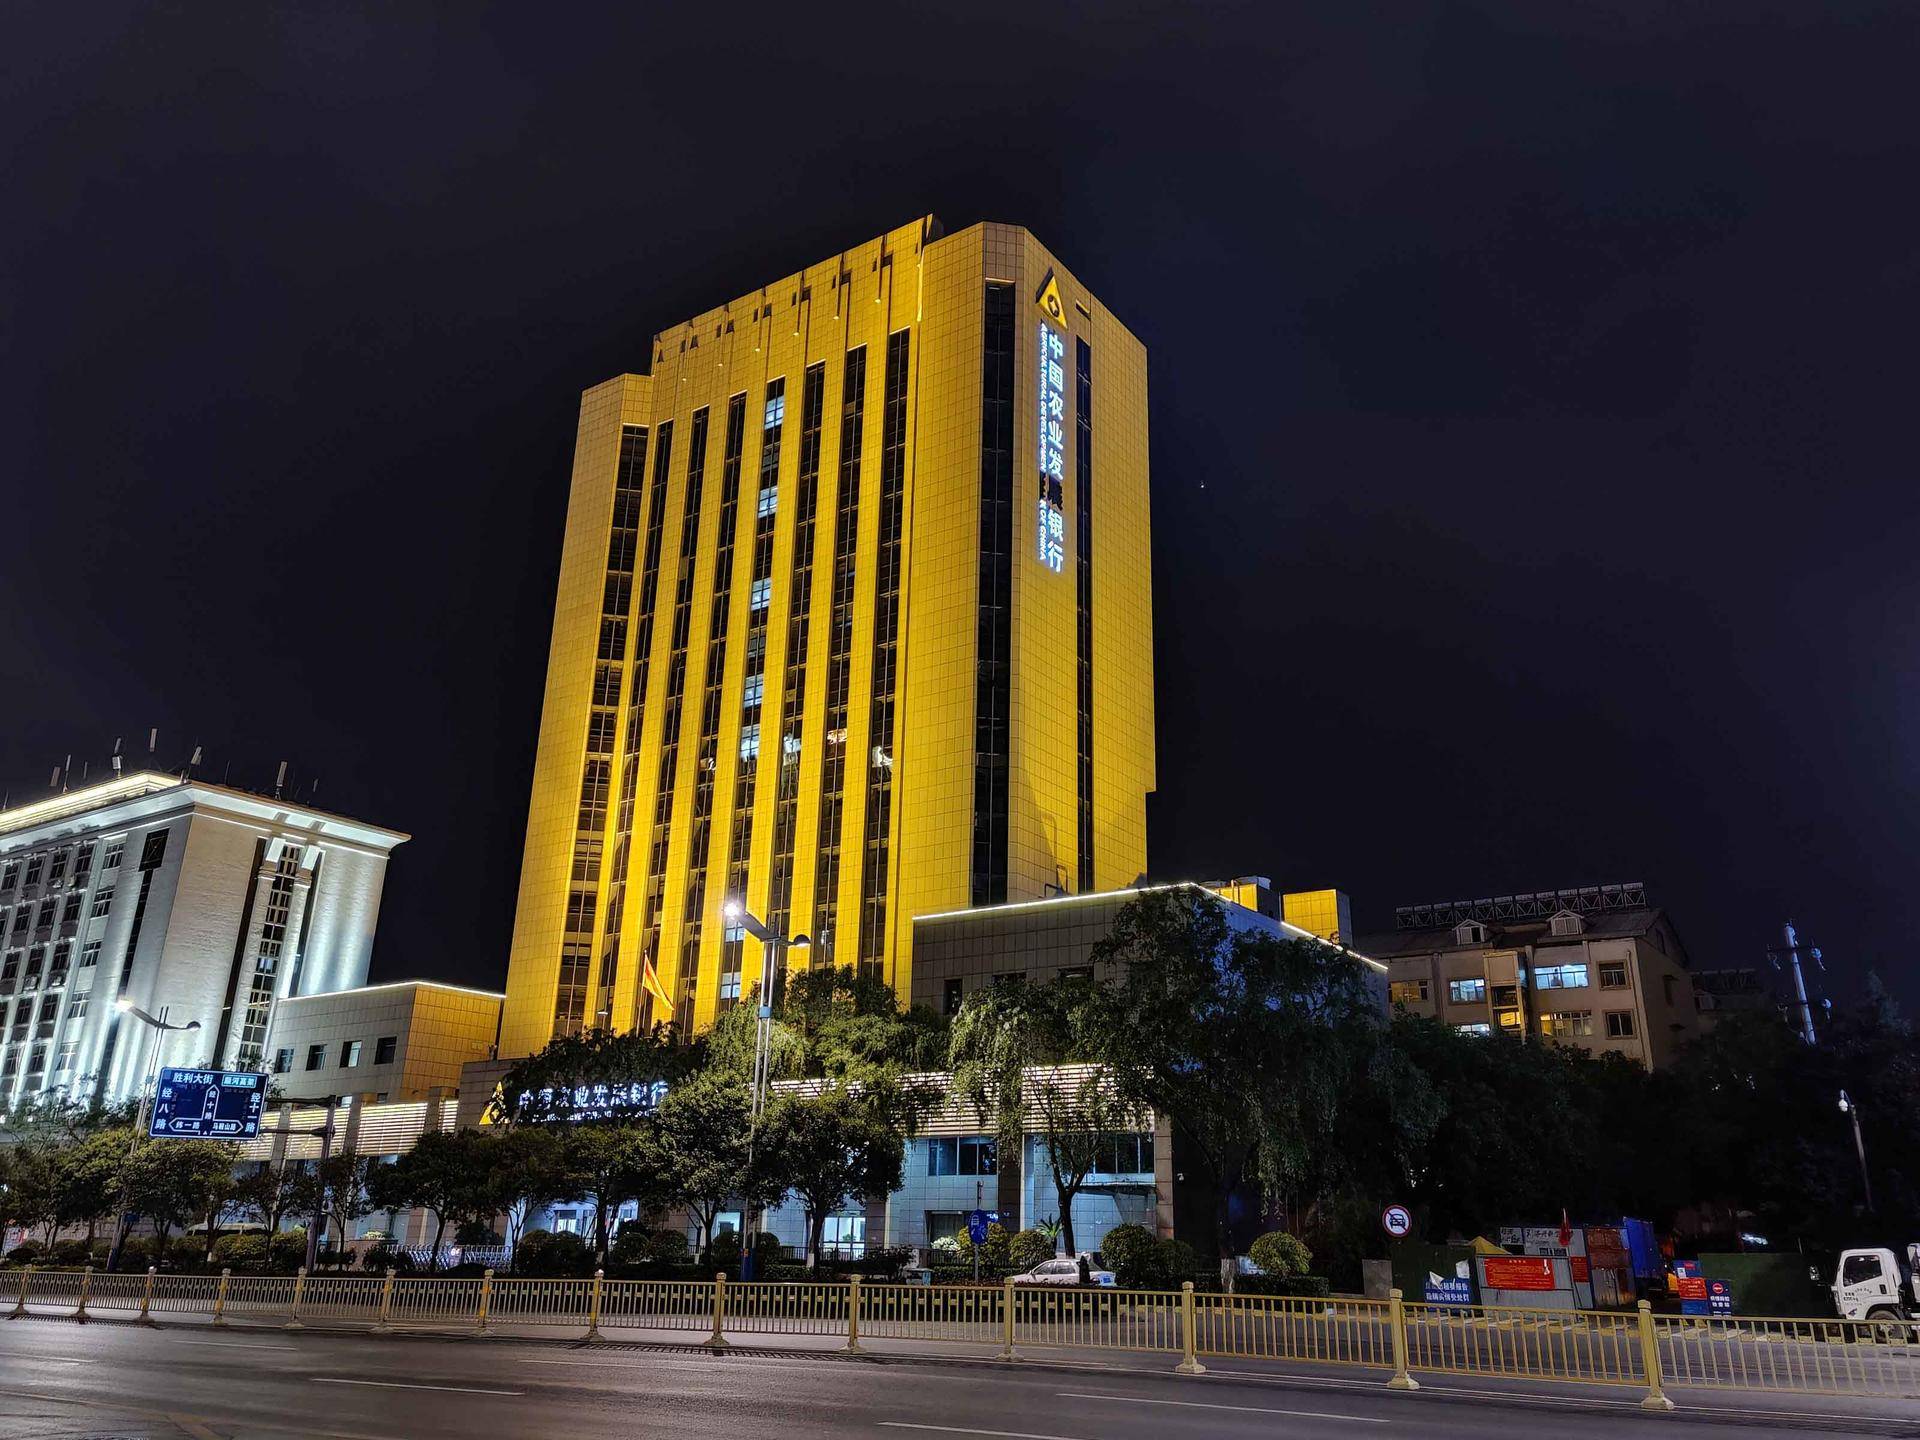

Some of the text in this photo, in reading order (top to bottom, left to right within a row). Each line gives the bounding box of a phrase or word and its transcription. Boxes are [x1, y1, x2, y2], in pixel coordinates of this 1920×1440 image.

[1040, 322, 1048, 400] AGRICULTURAL
[1048, 332, 1063, 573] 中国农业发银行
[172, 1072, 213, 1085] 胜利大街
[154, 1087, 173, 1130] 经八路
[244, 1092, 262, 1133] 经十一路
